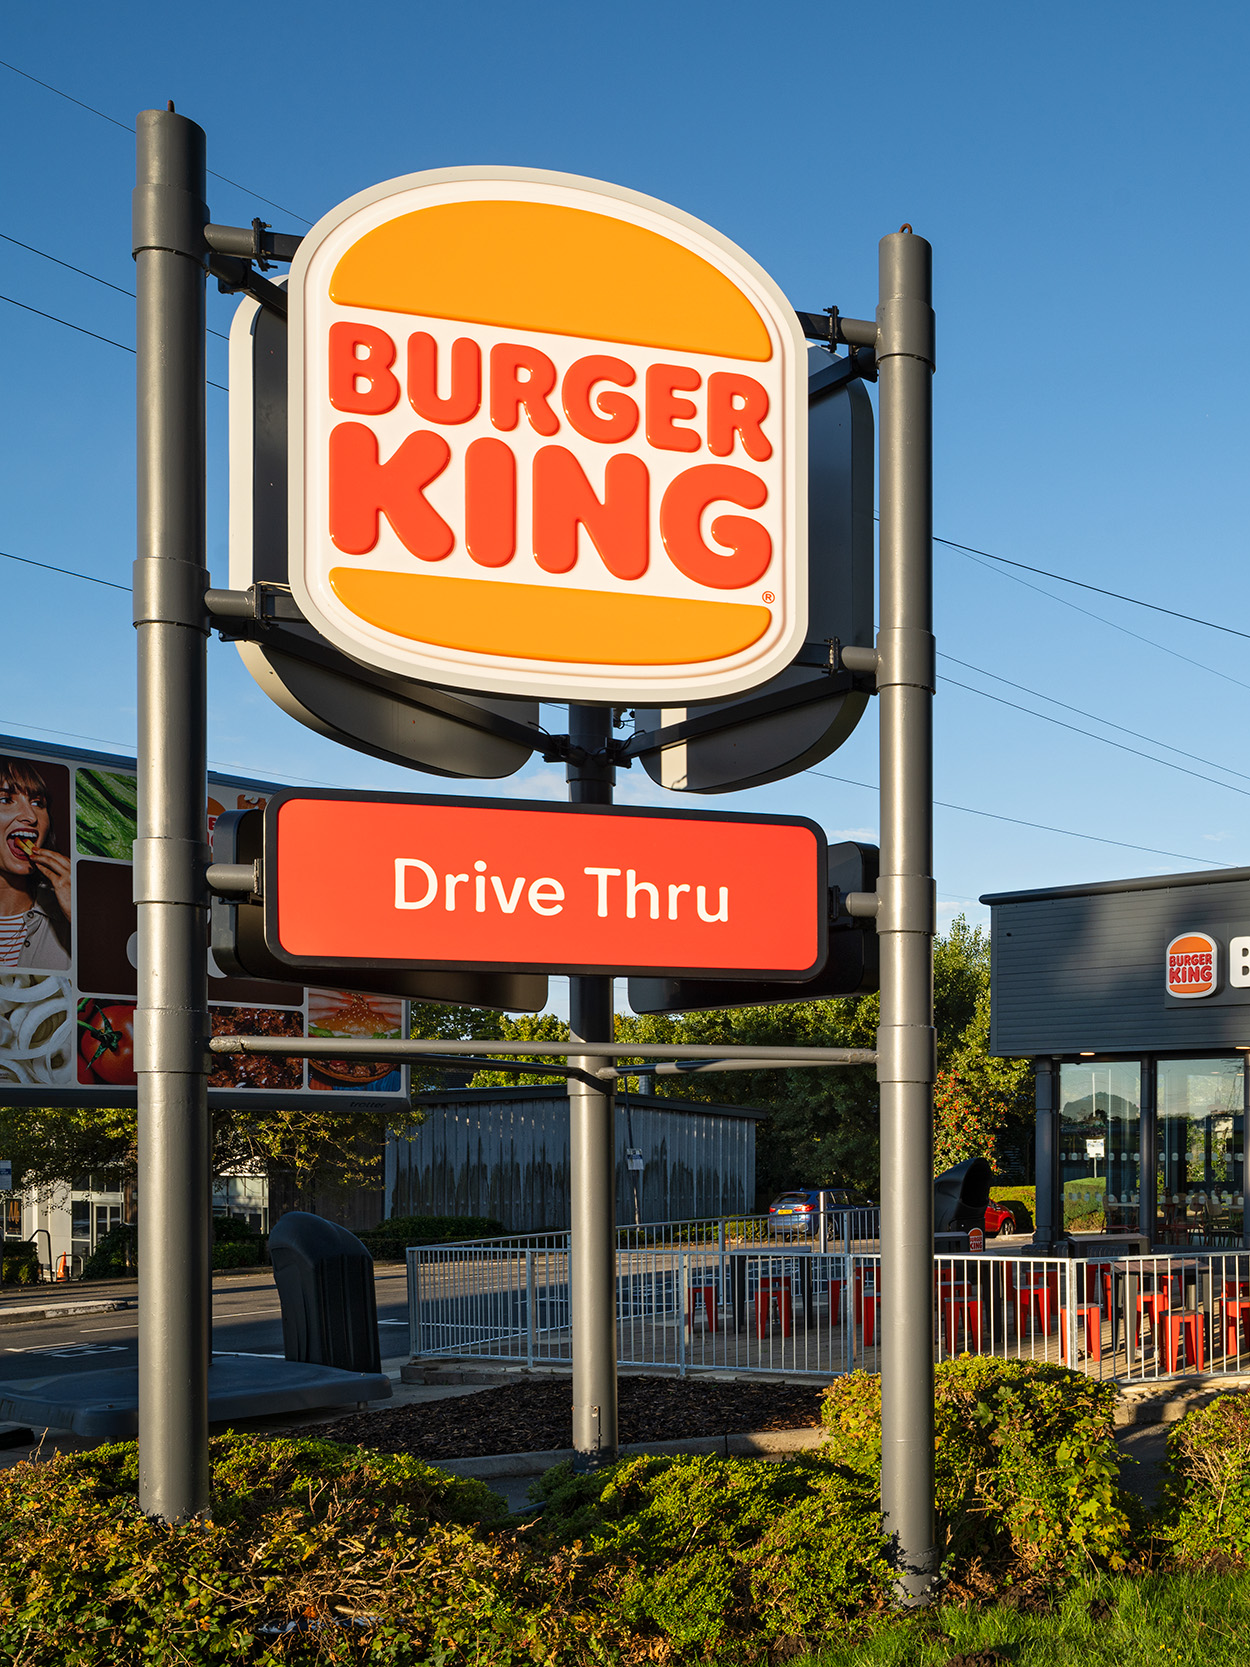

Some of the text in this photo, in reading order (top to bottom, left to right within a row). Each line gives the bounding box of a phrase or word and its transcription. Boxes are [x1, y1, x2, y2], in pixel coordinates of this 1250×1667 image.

[328, 321, 773, 463] BURGER
[328, 421, 773, 590] KING
[393, 857, 731, 923] Drive Thru
[1169, 953, 1212, 967] BURGER
[1169, 965, 1212, 983] KING
